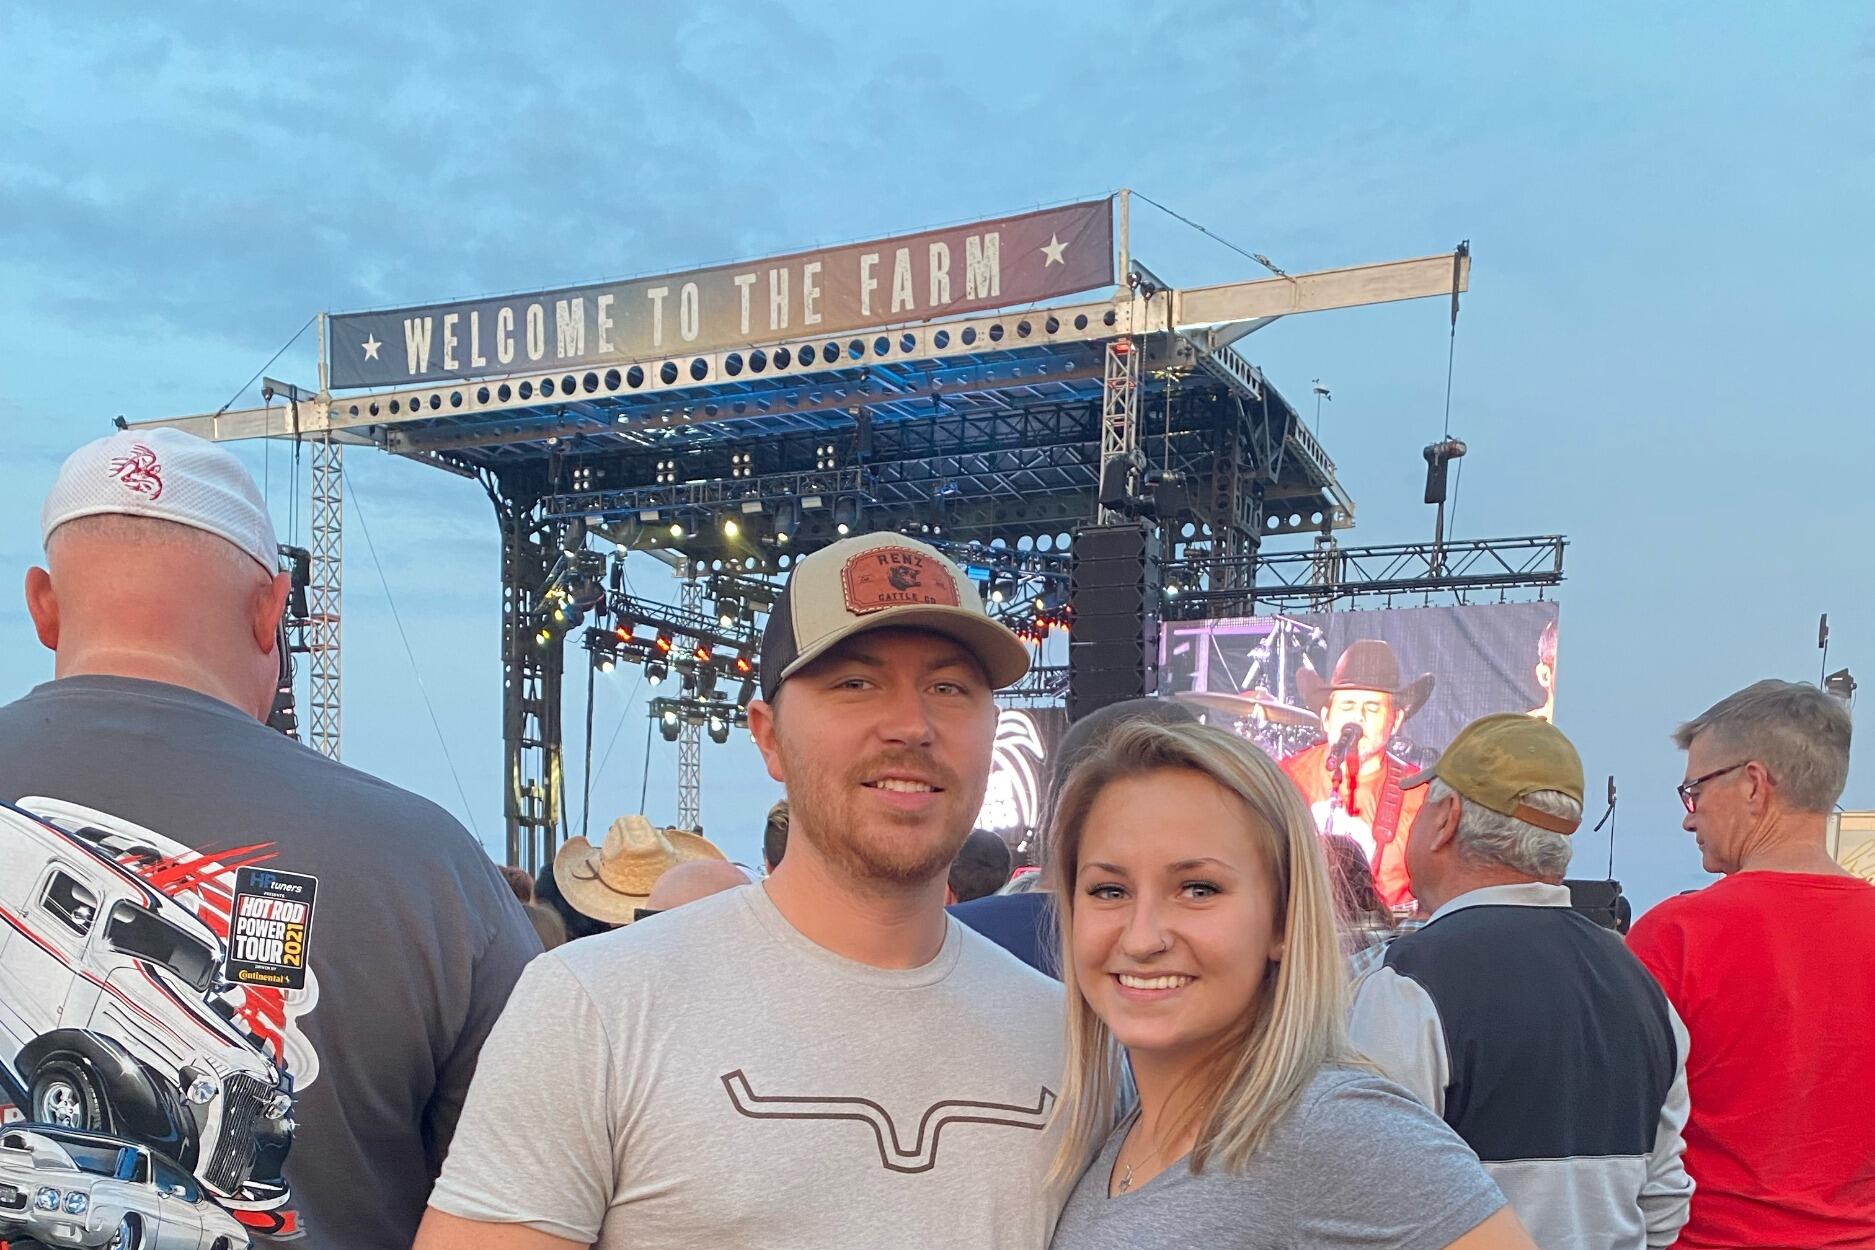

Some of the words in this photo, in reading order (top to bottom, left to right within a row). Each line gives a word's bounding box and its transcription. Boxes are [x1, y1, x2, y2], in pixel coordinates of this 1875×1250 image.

[403, 293, 615, 375] WELCOME
[647, 282, 699, 347] TO
[733, 261, 822, 335] THE
[860, 231, 1001, 317] FARM
[877, 552, 924, 568] RENZ
[250, 871, 276, 888] HP
[270, 881, 303, 893] tuners
[241, 896, 273, 919] HOT
[270, 901, 304, 924] ROD
[236, 917, 286, 940] POWER
[235, 934, 284, 965] TOUR
[283, 923, 304, 967] 2021
[238, 969, 285, 984] Continental
